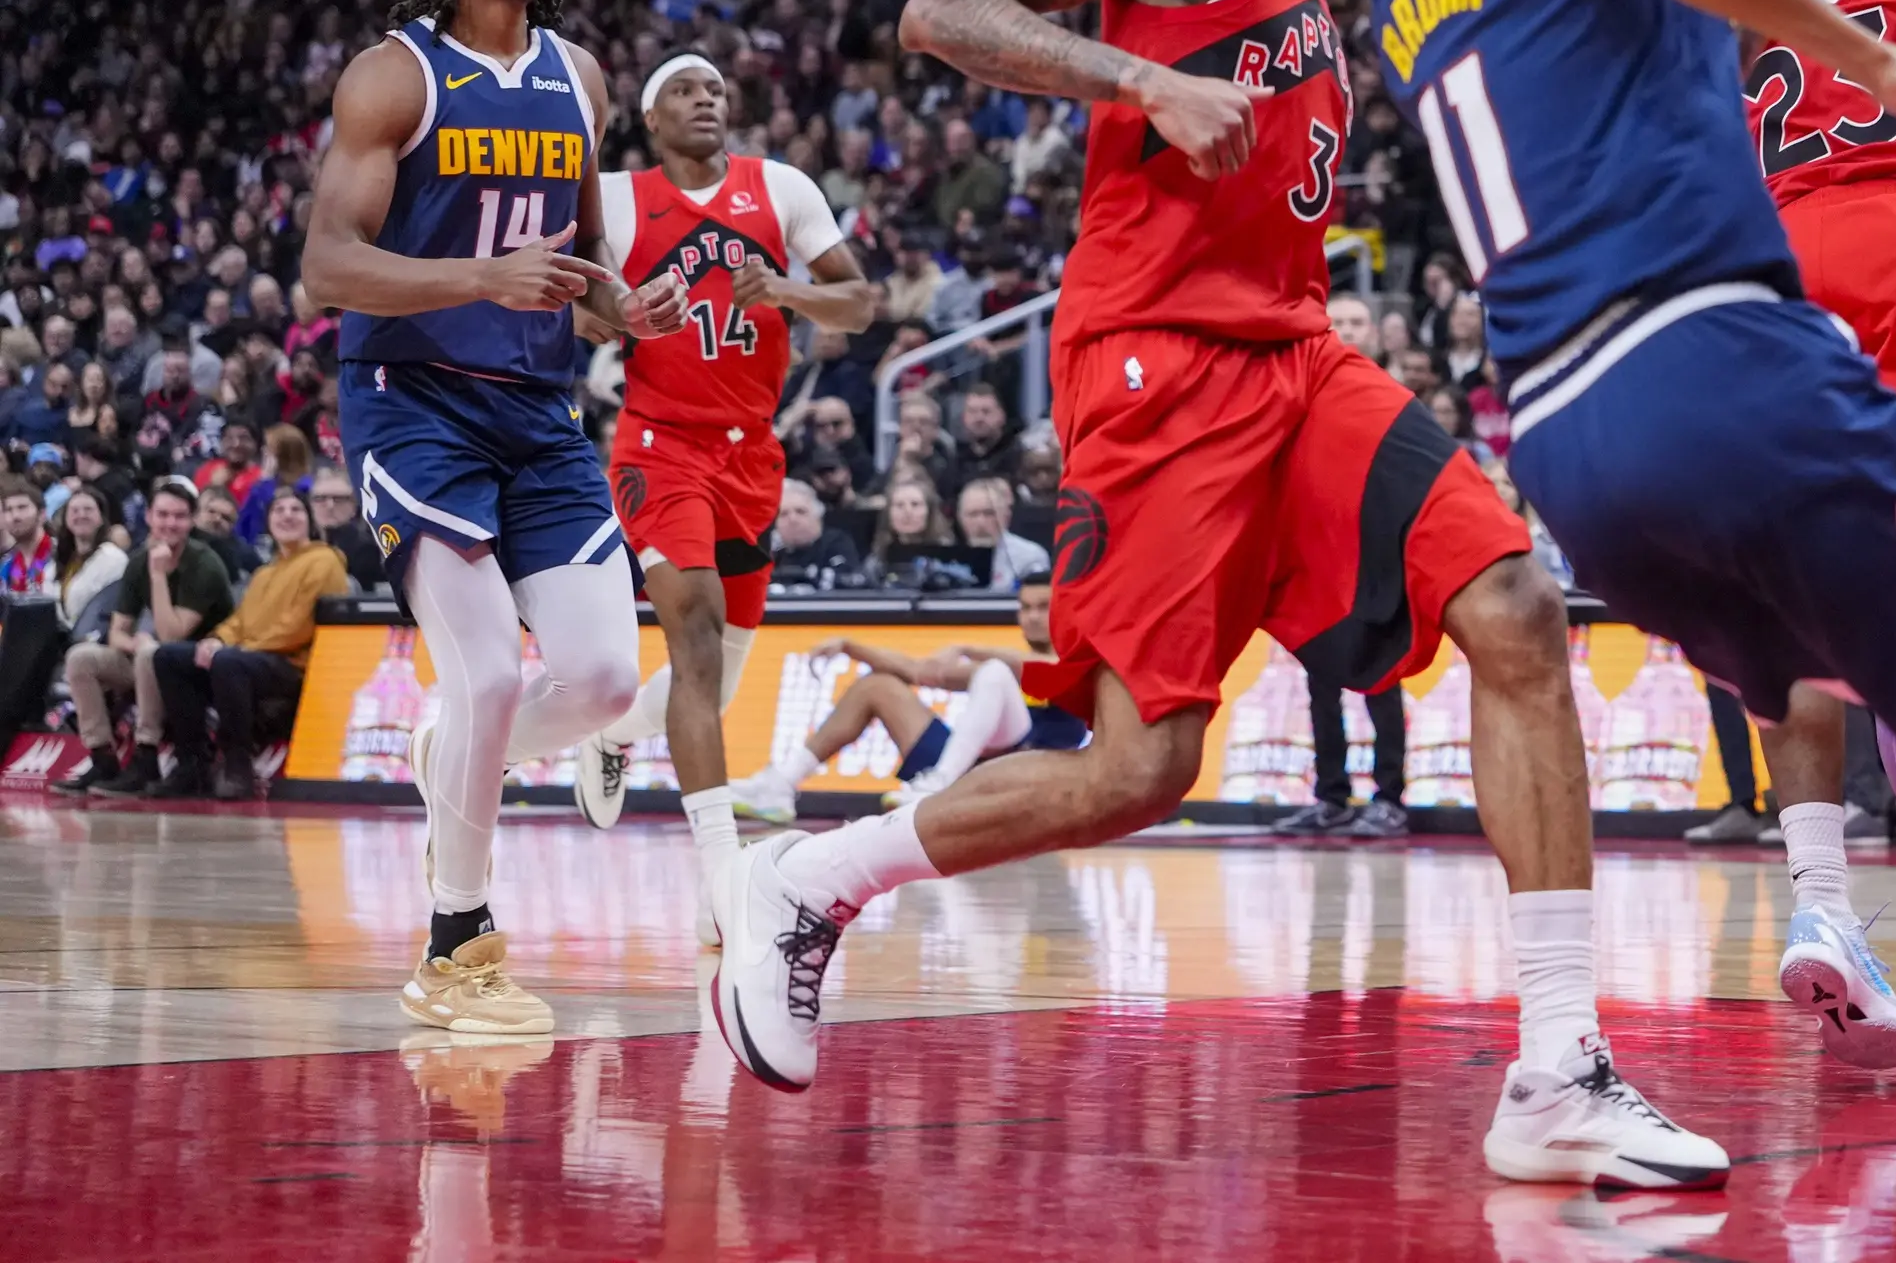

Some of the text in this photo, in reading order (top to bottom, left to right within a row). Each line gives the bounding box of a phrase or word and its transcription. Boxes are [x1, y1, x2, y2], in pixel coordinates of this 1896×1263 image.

[531, 75, 571, 94] ibotta
[436, 127, 584, 181] DENVER
[1287, 116, 1340, 223] 3
[1416, 51, 1530, 285] 11
[474, 188, 546, 259] 14
[687, 299, 758, 361] 14
